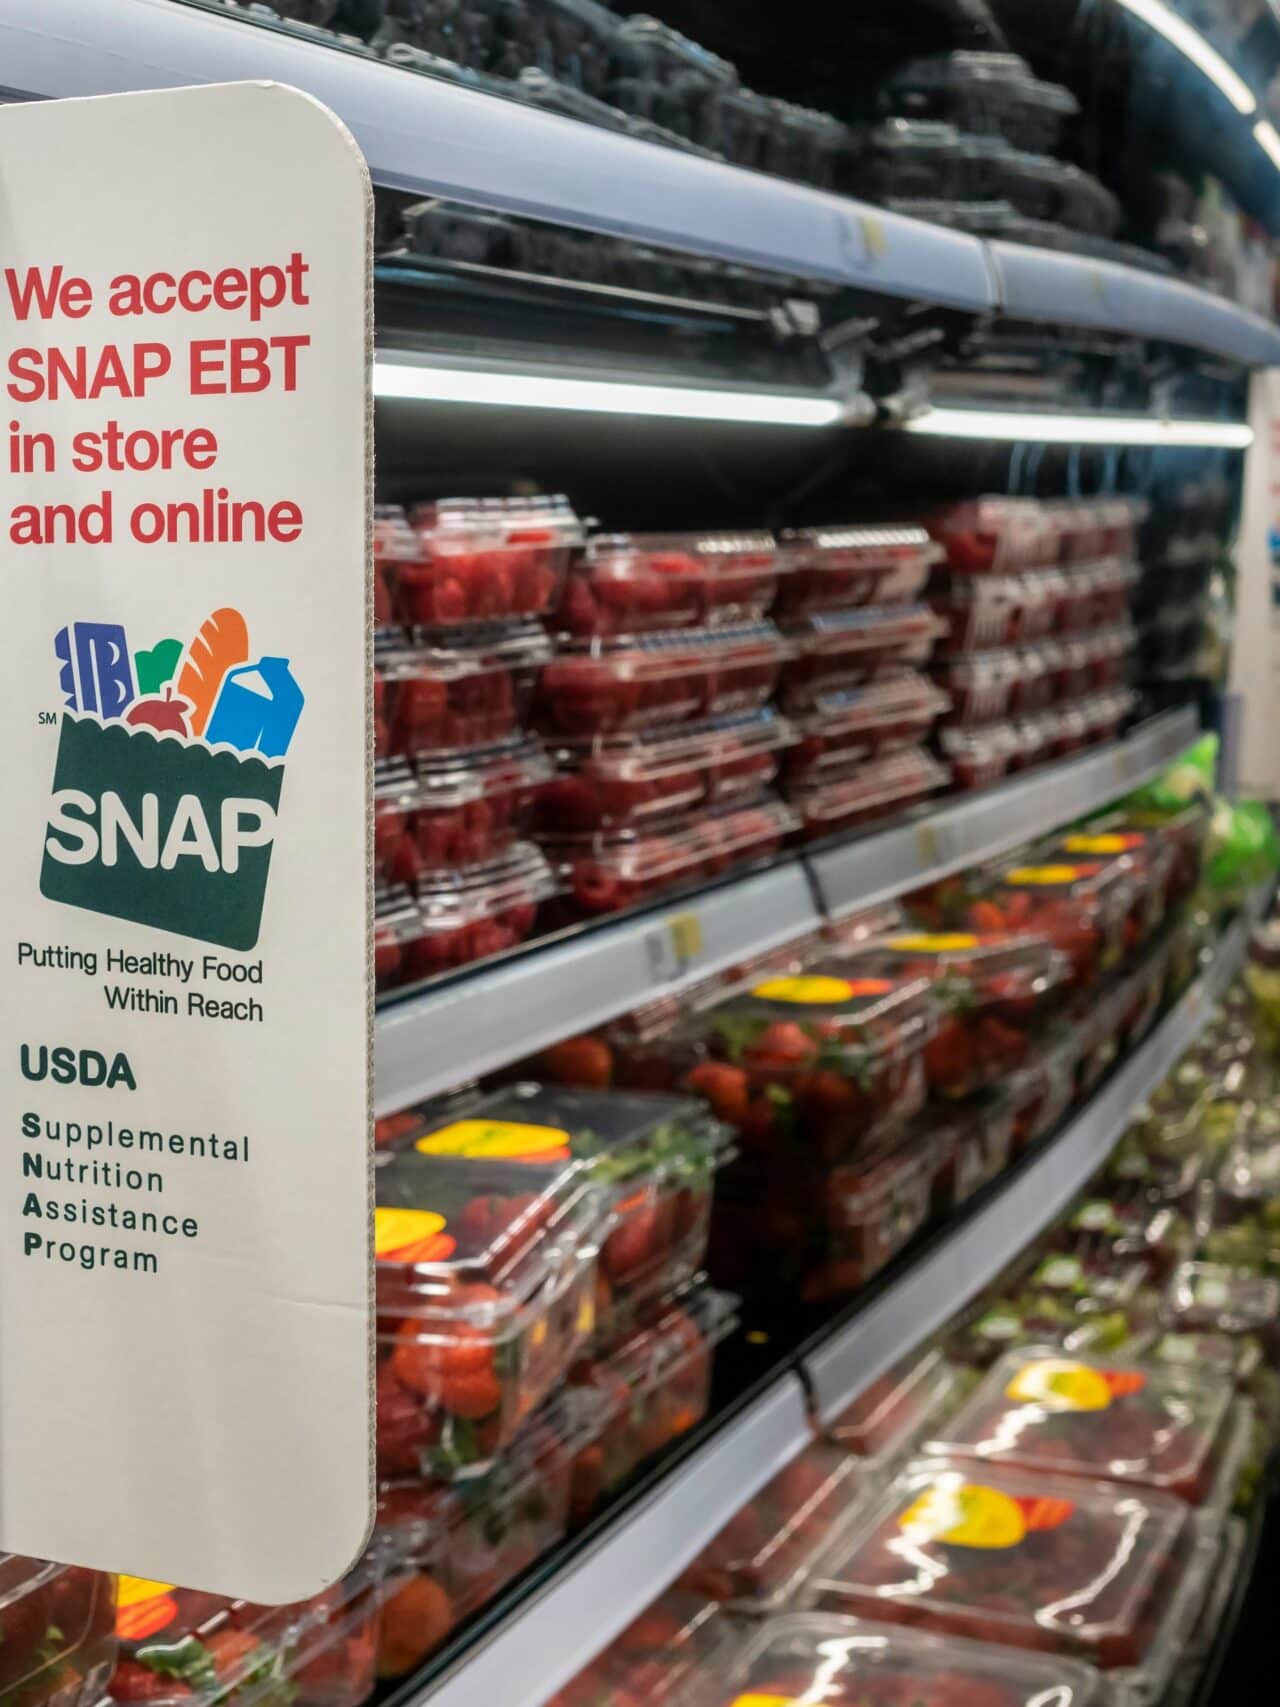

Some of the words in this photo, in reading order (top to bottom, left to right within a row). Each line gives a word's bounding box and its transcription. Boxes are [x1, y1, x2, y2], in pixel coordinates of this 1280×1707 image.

[4, 265, 93, 321] We
[108, 252, 310, 322] accept
[6, 342, 171, 402] SNAP
[189, 335, 311, 395] EBT
[9, 421, 56, 473] in
[71, 421, 218, 473] store
[9, 490, 113, 545] and
[129, 487, 303, 544] online
[38, 712, 57, 725] SM
[45, 788, 279, 874] SNAP
[17, 942, 97, 976] Putting
[106, 948, 194, 983] Healthy
[202, 956, 263, 984] Food
[104, 985, 178, 1015] Within
[188, 992, 264, 1022] Reach
[20, 1043, 137, 1091] USDA
[21, 1112, 249, 1162] Supplemental
[23, 1152, 163, 1193] Nutrition
[22, 1192, 198, 1237] Assistance
[24, 1232, 158, 1273] Program
